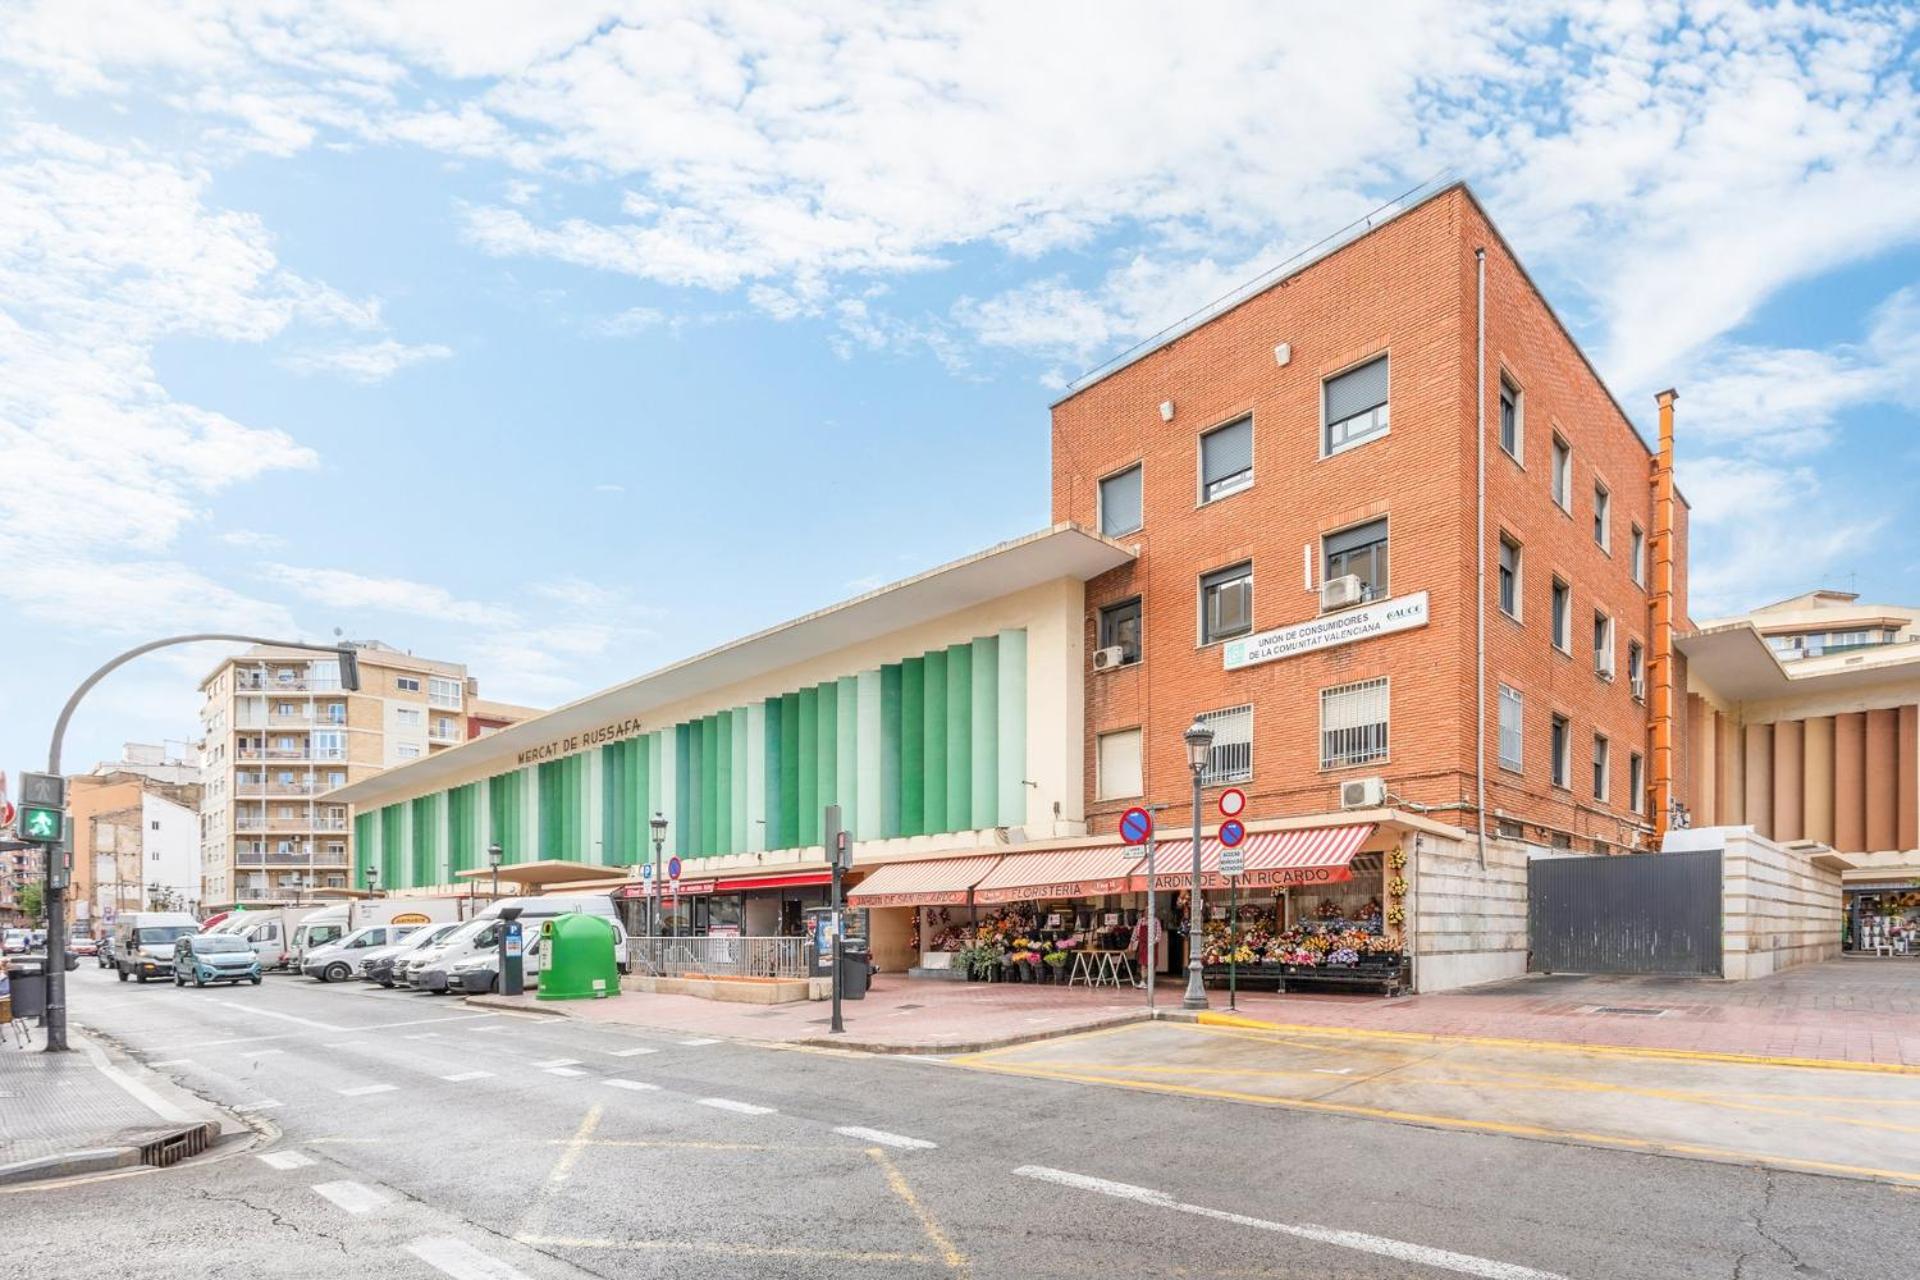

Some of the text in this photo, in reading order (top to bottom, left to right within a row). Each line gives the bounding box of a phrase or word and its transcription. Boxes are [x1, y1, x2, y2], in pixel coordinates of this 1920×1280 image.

[1249, 650, 1260, 660] DE
[1261, 648, 1272, 657] LA
[1273, 634, 1322, 654] COMUNITAT
[1324, 622, 1381, 642] VALENCIANA
[1286, 630, 1298, 641] DE
[1299, 612, 1369, 638] CONSUMIDORES
[517, 718, 641, 764] MERCAT DE RUSSAFA
[1155, 868, 1330, 889] ARDIN DE SAN RICARDO
